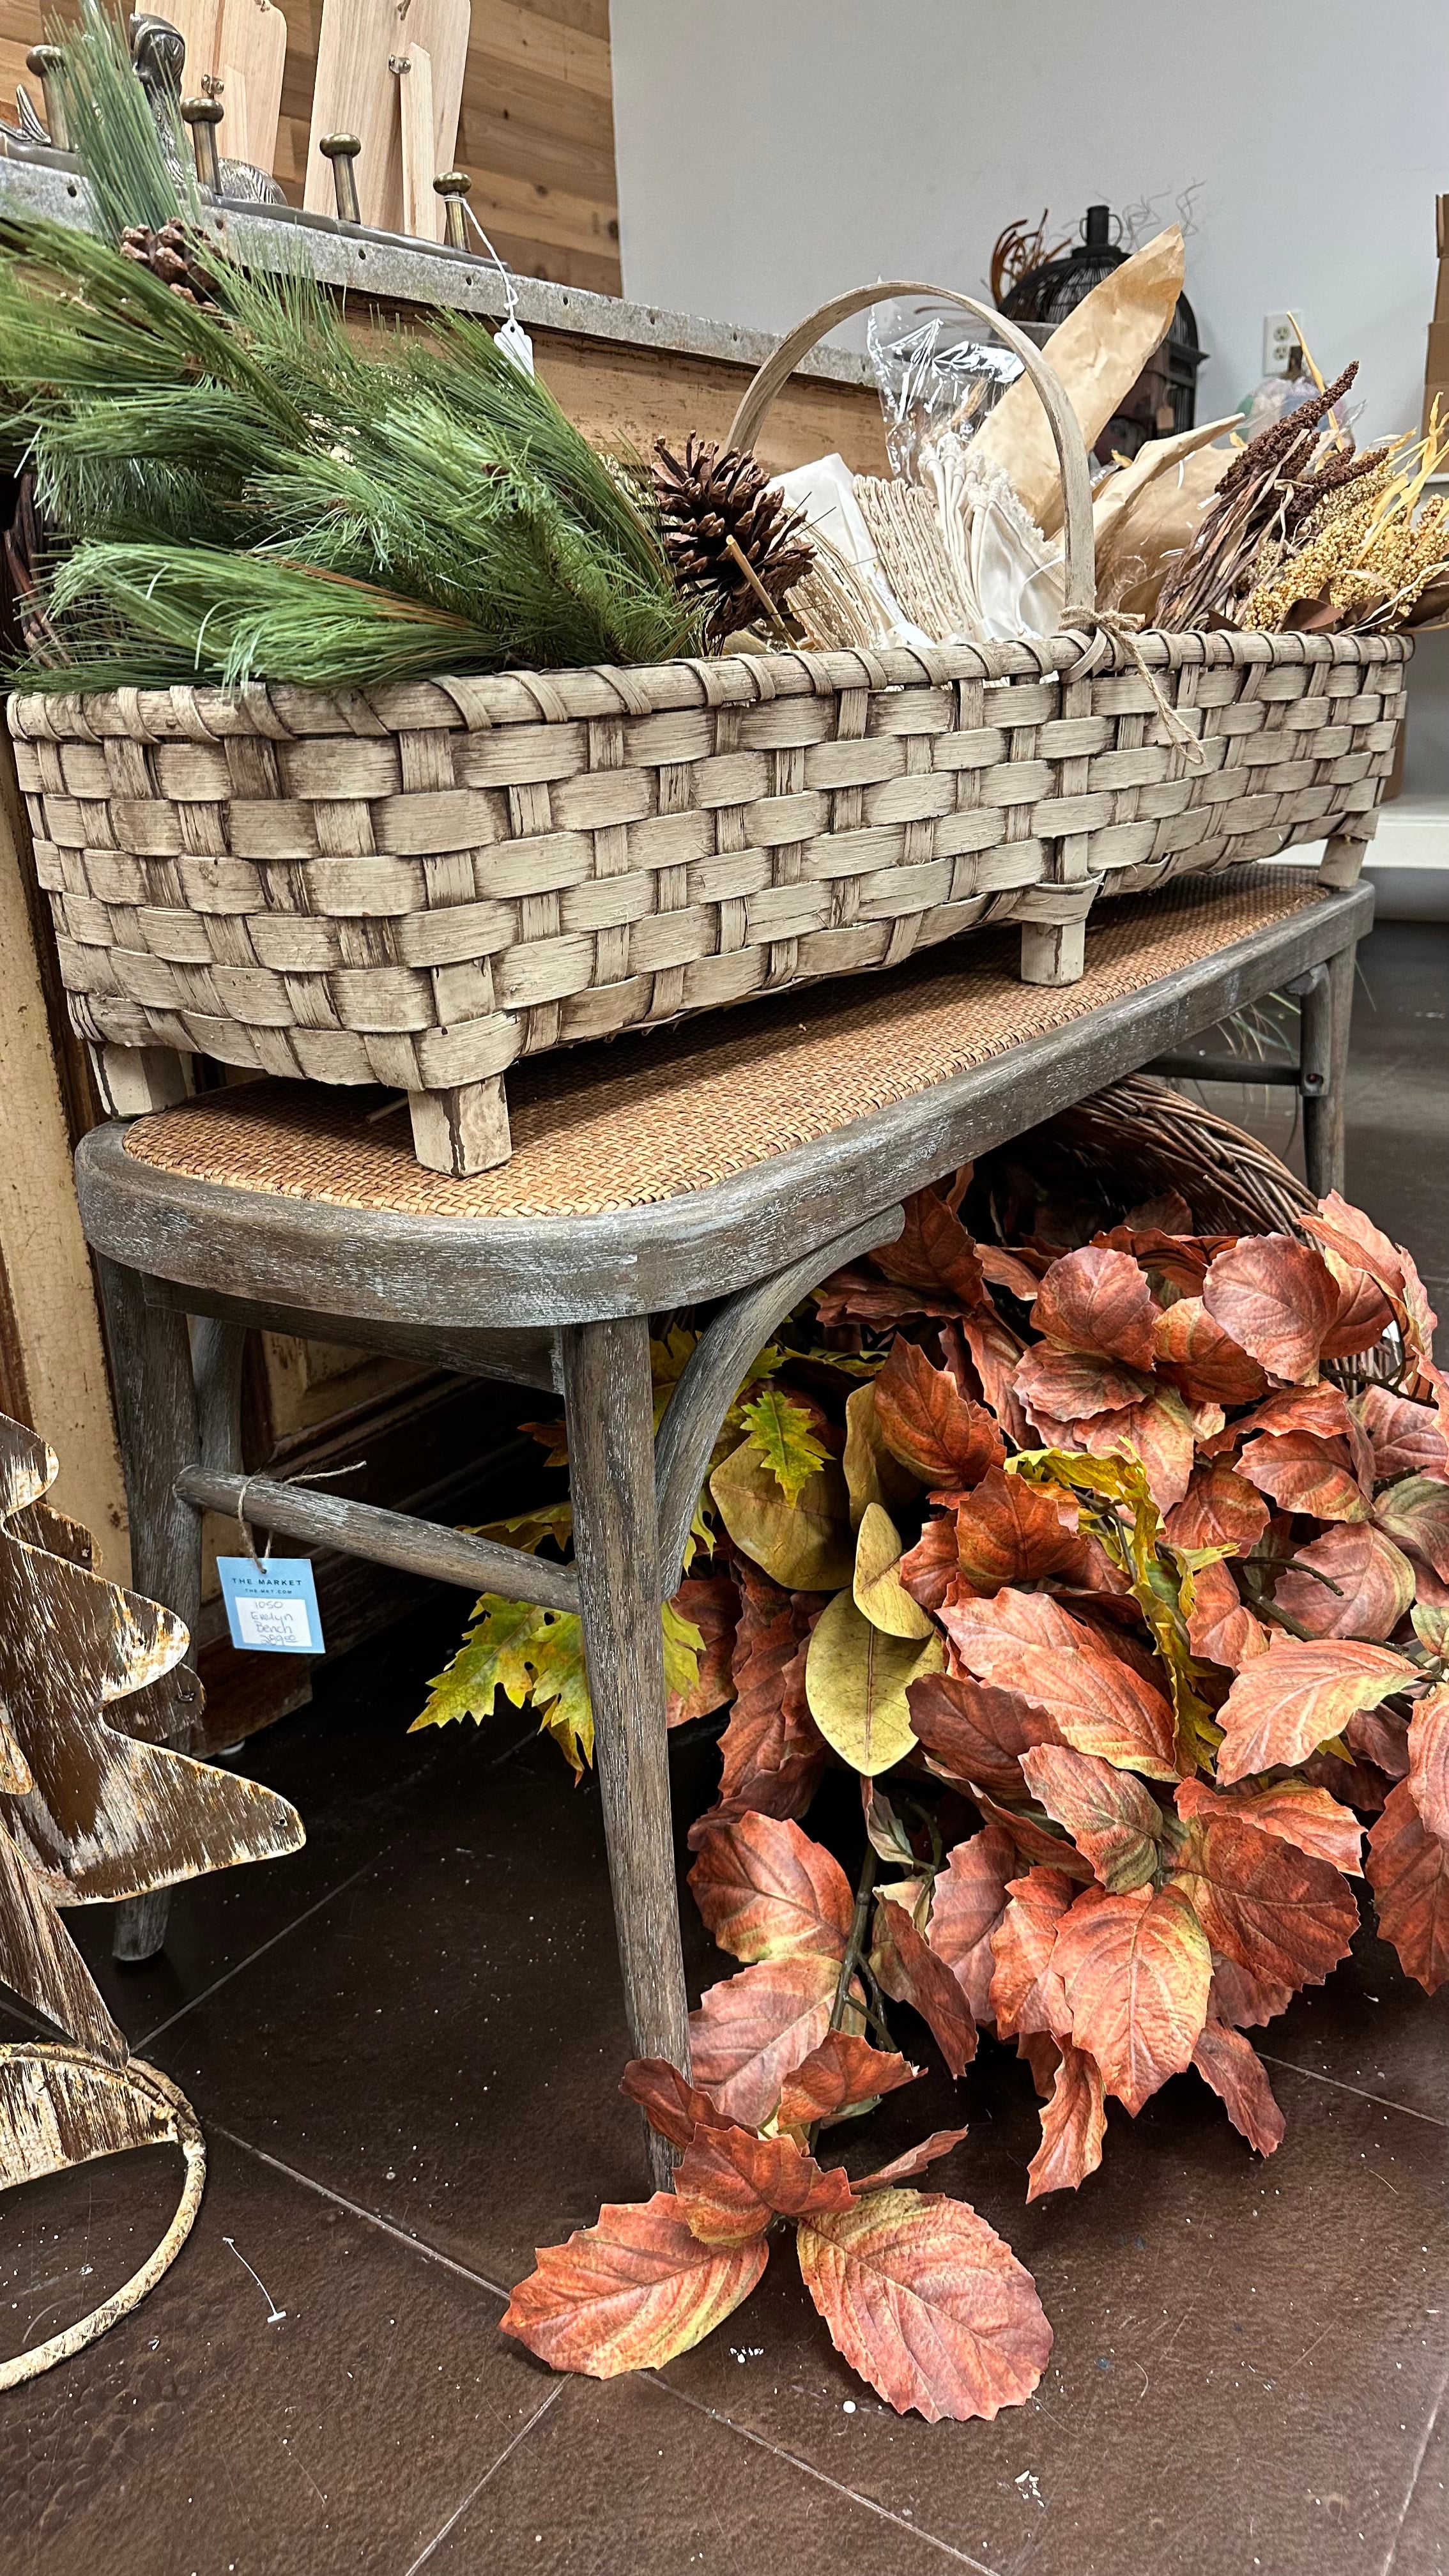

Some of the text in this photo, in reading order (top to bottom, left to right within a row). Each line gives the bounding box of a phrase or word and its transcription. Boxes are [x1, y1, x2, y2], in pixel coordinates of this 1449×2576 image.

[254, 1600, 283, 1609] 1050
[250, 1611, 293, 1623] Evelyn
[254, 1620, 293, 1634] Bench
